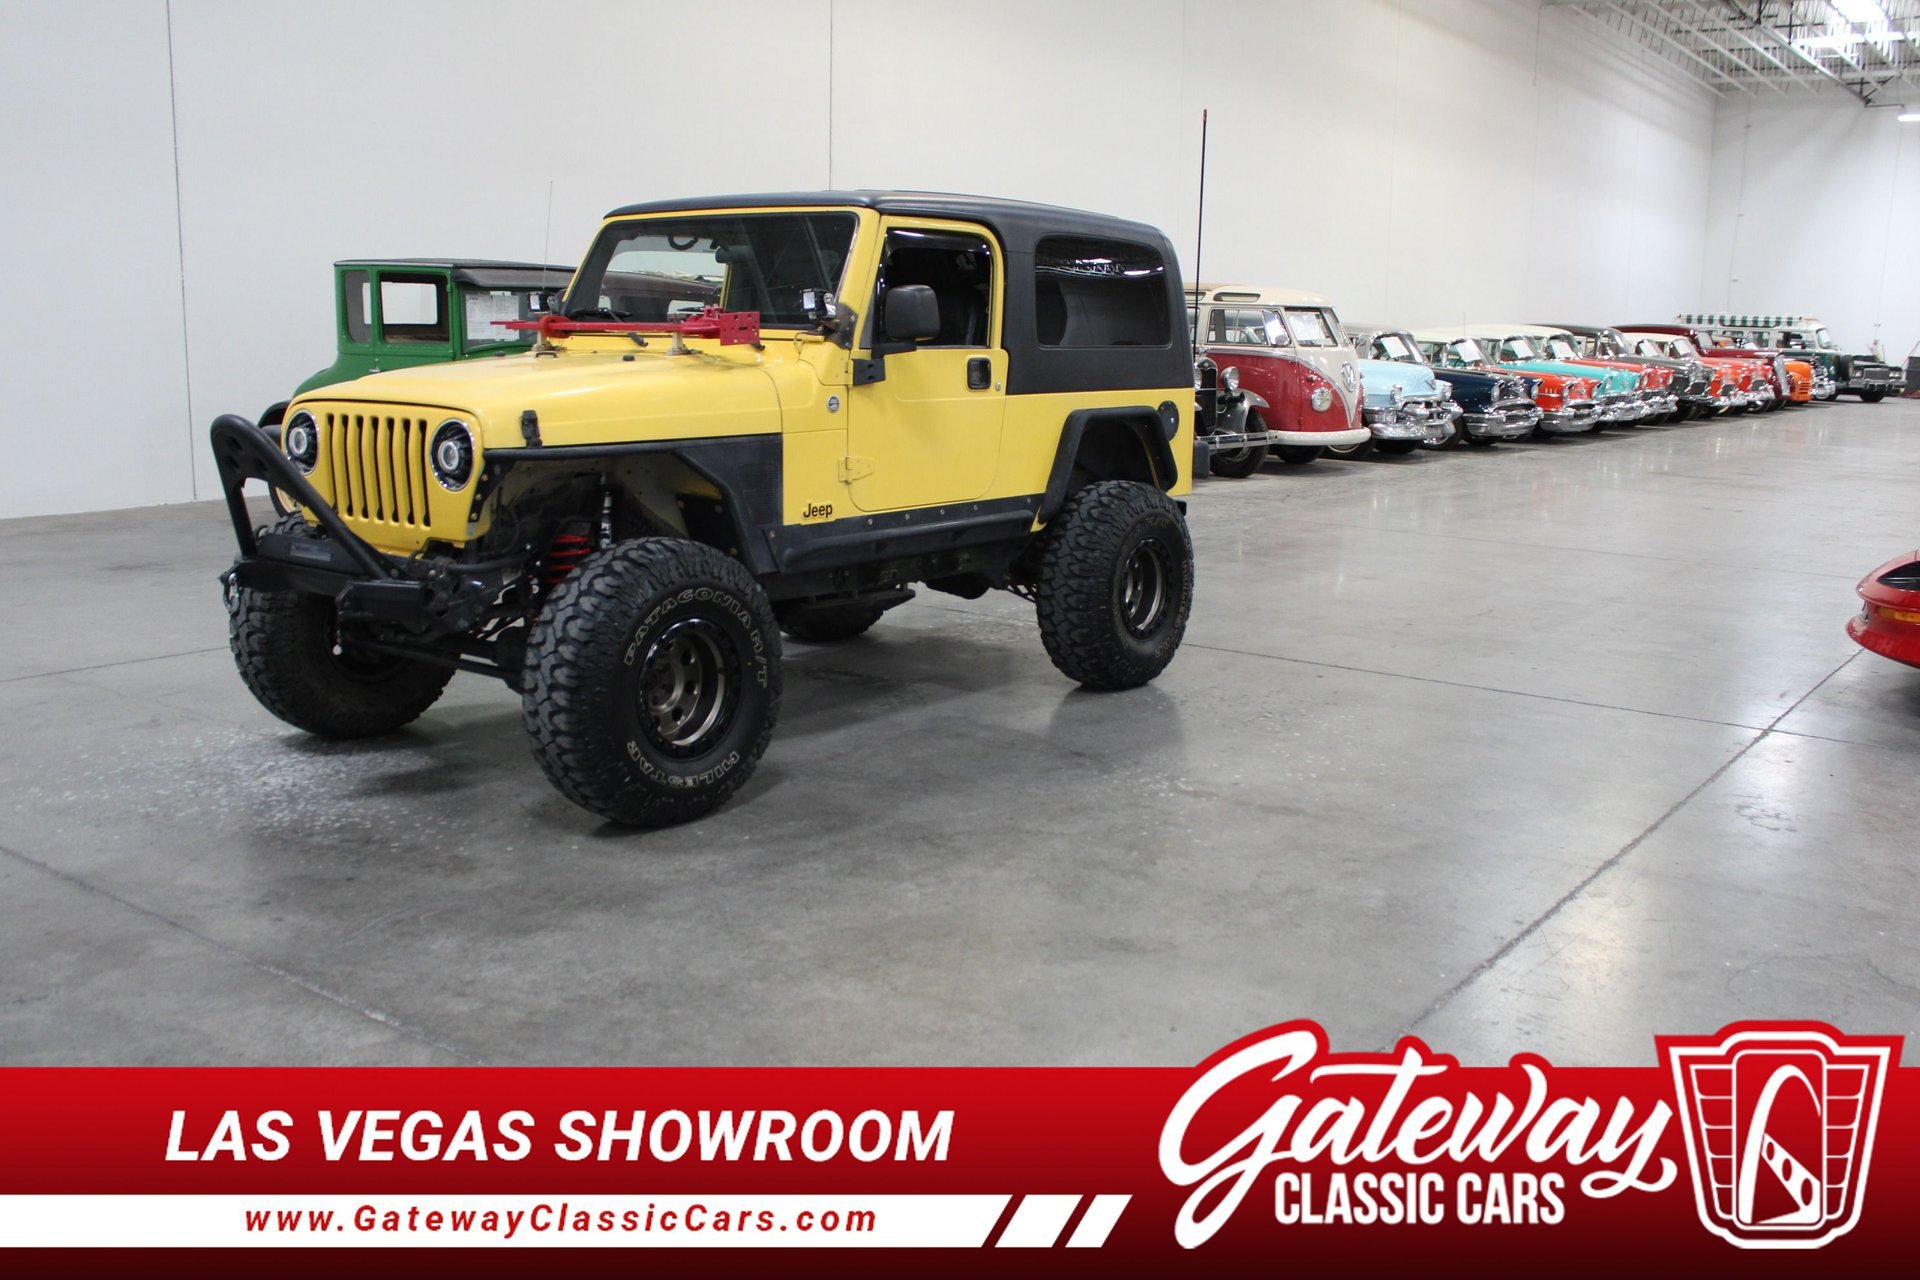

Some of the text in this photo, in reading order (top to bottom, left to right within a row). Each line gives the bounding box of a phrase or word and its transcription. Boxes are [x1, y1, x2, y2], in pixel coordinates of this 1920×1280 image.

[803, 503, 833, 518] Jeep
[623, 587, 768, 688] PATAGONIA M/T
[626, 740, 740, 789] MILLESTAR
